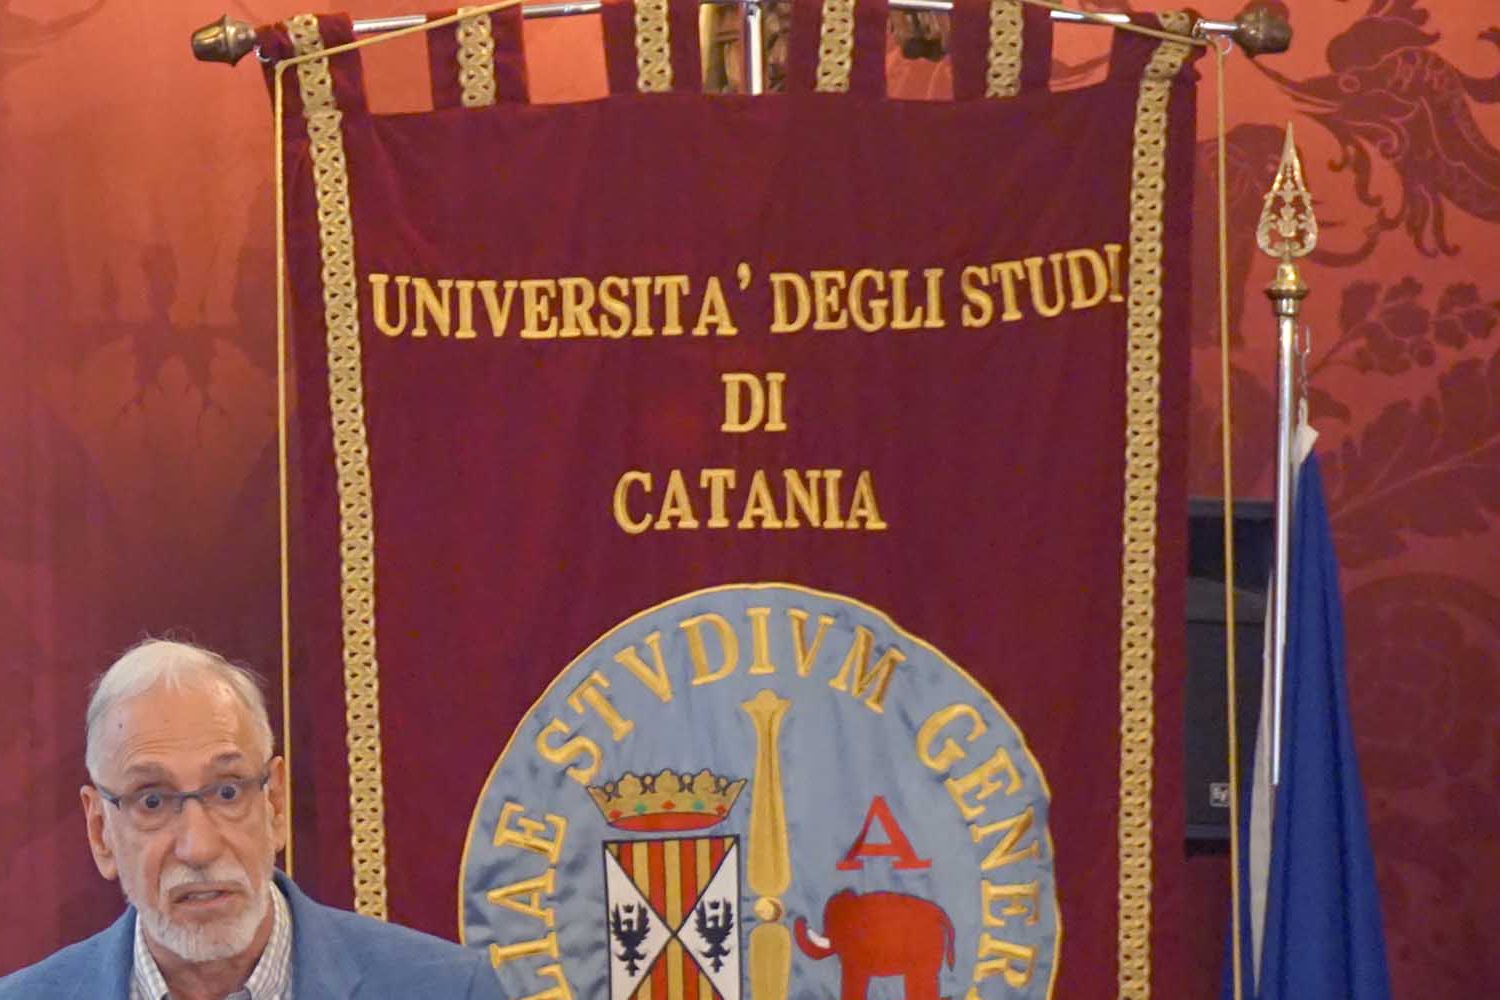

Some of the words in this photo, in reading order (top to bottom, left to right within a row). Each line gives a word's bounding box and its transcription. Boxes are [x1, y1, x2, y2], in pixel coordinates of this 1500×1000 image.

[368, 262, 751, 340] UNIVERSITA'
[768, 266, 945, 335] DEGLI
[960, 243, 1125, 329] STUDI
[720, 372, 787, 434] DI
[612, 468, 888, 535] CATANIA
[535, 607, 906, 785] STVDIVM
[835, 795, 933, 871] A
